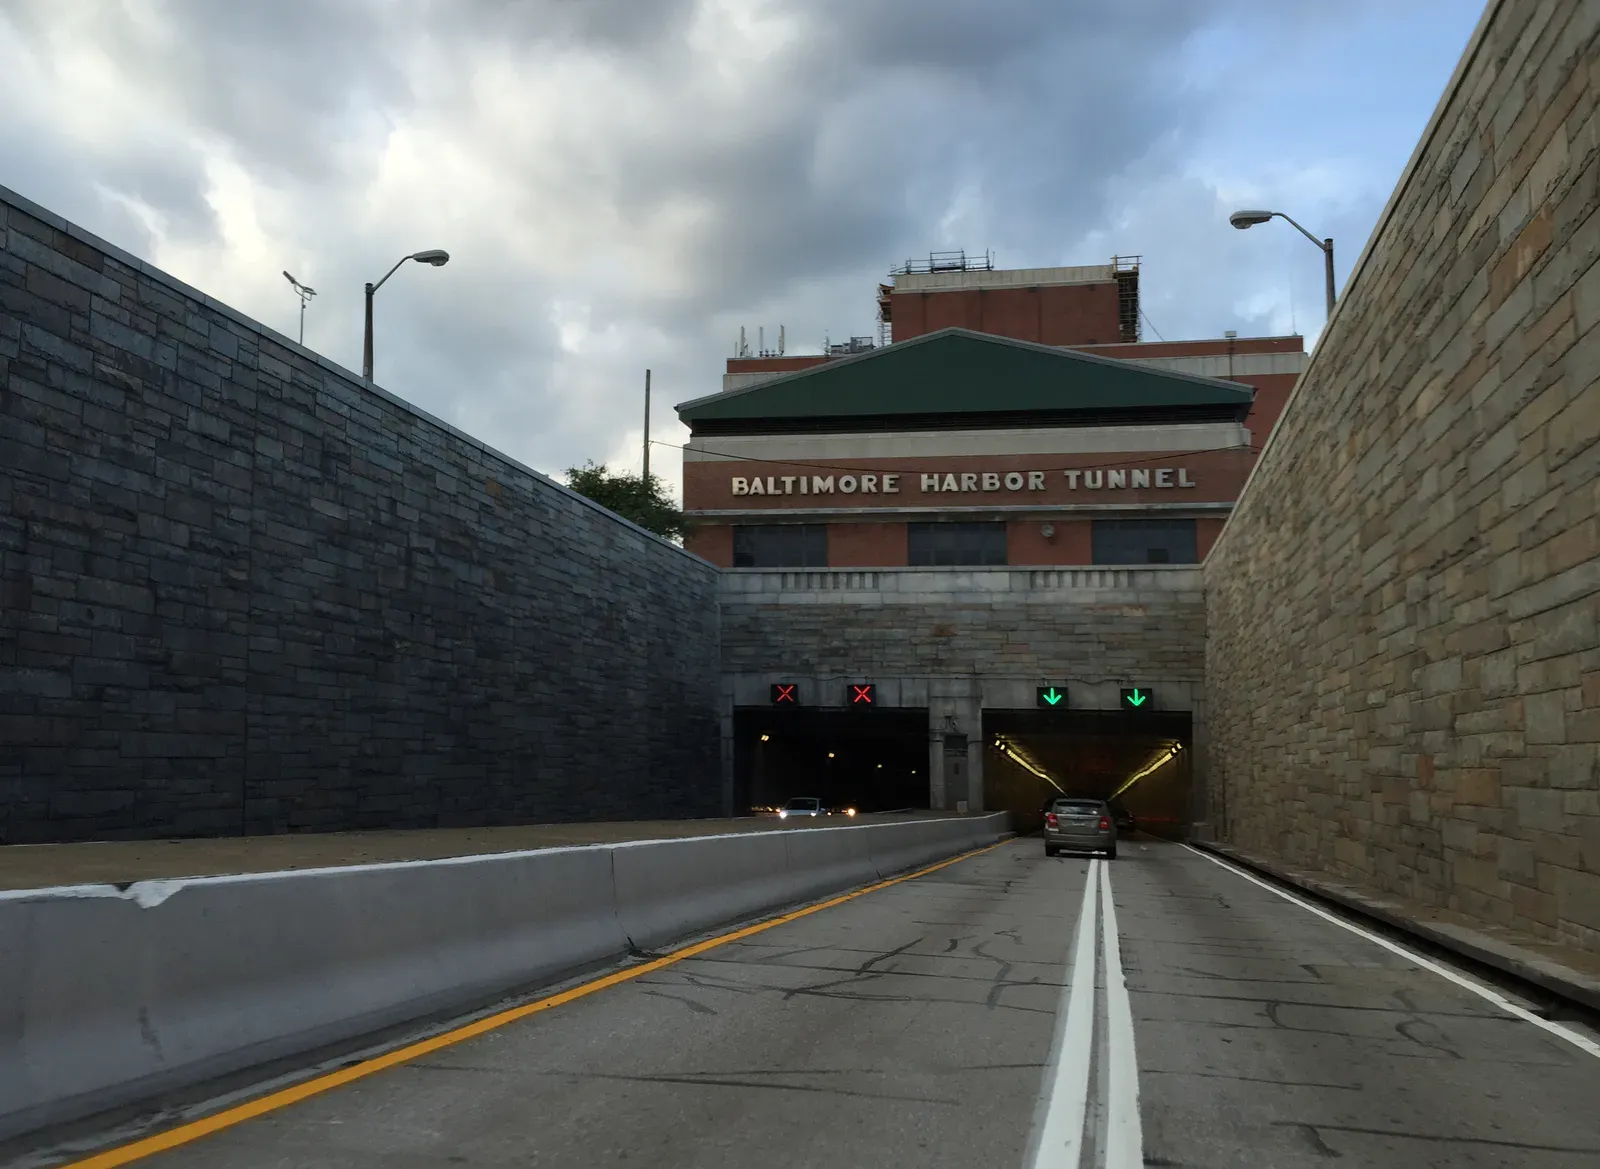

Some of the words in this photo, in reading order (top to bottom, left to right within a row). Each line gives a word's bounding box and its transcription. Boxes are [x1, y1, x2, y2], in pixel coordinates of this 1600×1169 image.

[731, 474, 900, 496] BALTIMORE
[920, 471, 1046, 493] HARBOR
[1064, 468, 1196, 490] TUNNEL
